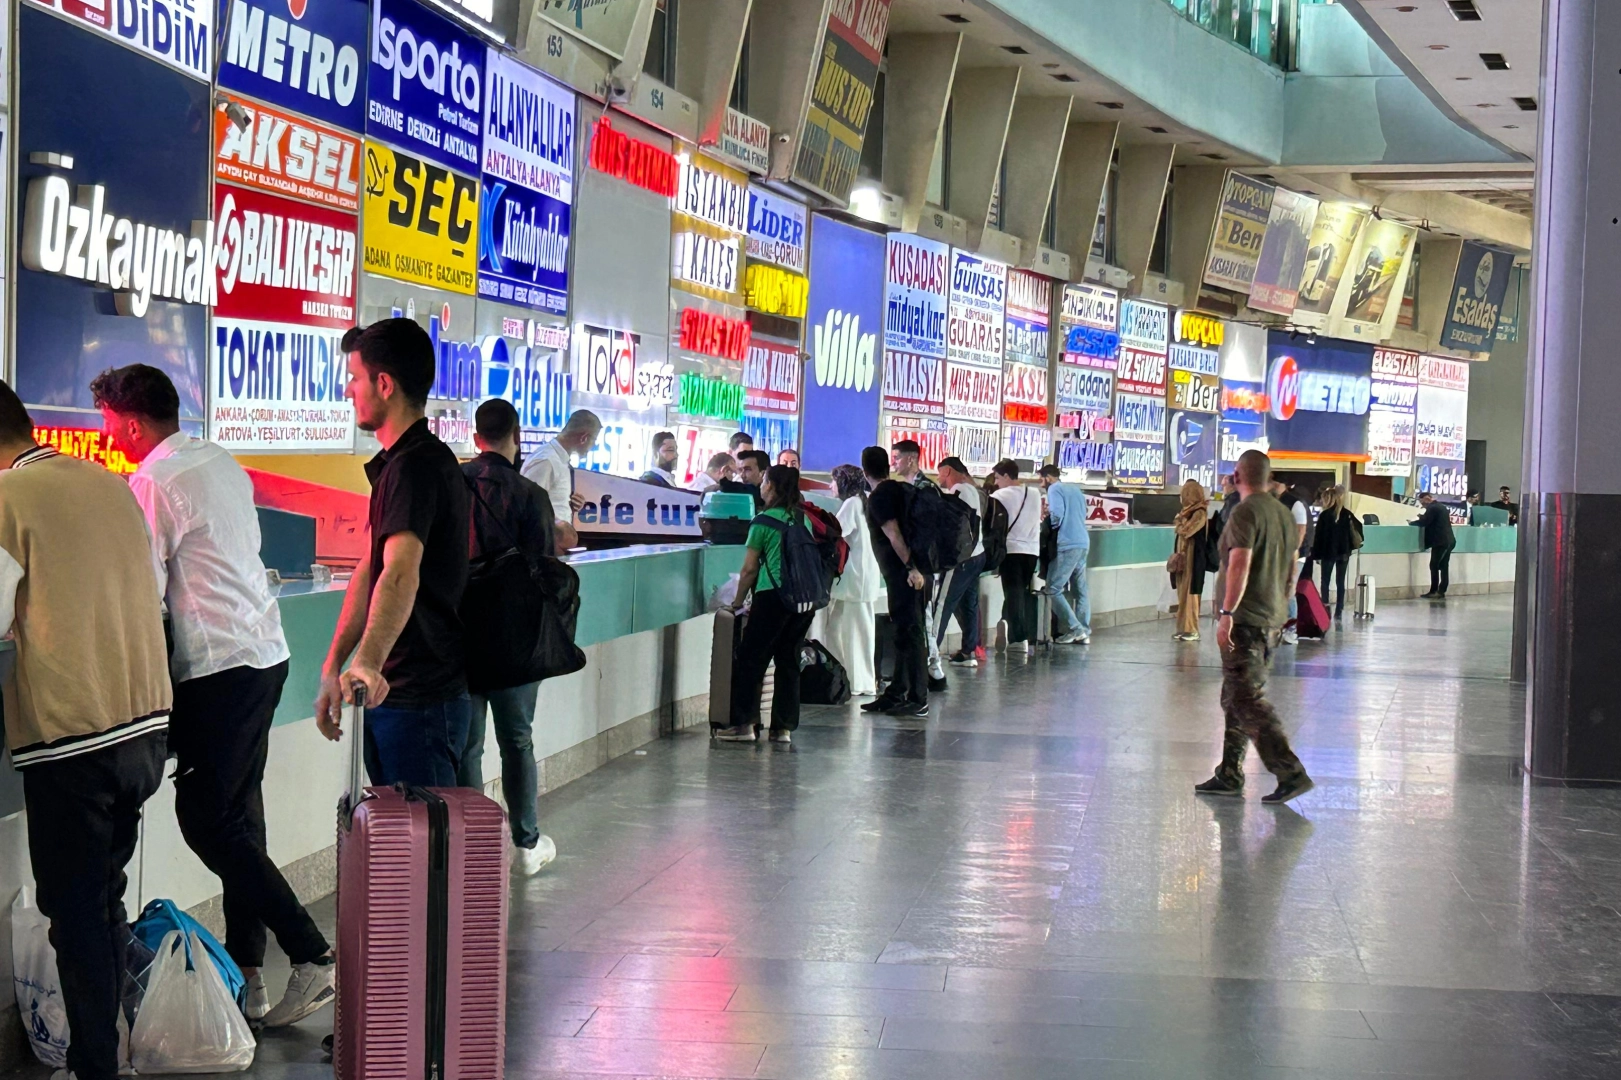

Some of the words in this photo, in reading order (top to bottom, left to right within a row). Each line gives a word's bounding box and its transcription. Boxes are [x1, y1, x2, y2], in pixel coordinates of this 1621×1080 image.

[117, 0, 207, 74] DİDİM
[227, 0, 359, 107] METRO
[547, 34, 562, 57] 153
[488, 72, 571, 171] ALANYALILAR
[650, 88, 664, 111] 154
[218, 105, 359, 196] AKSEL
[369, 100, 404, 132] EDİRNE
[443, 132, 477, 165] ANTALYA
[243, 170, 258, 183] ÇAY
[26, 152, 220, 318] Özkaymak
[749, 192, 804, 247] LİDER
[1227, 220, 1263, 251] Ben
[240, 210, 356, 298] BALIKESİR
[365, 246, 391, 270] ADANA
[889, 240, 947, 296] KUŞADASI
[887, 295, 925, 344] midyat
[1452, 287, 1499, 338] Esadaş
[217, 327, 285, 400] TOKAT
[815, 308, 876, 392] Villa
[884, 352, 944, 402] AMASYA
[1298, 370, 1371, 415] METRO
[215, 407, 248, 422] ANKARA
[218, 427, 252, 441] ARTOVA
[257, 427, 301, 444] YEŞİLYURT
[304, 427, 347, 441] SULUSARAY
[1117, 396, 1147, 431] Mersin
[1430, 466, 1468, 500] Esadaş
[578, 494, 634, 525] efe
[646, 498, 701, 526] tur
